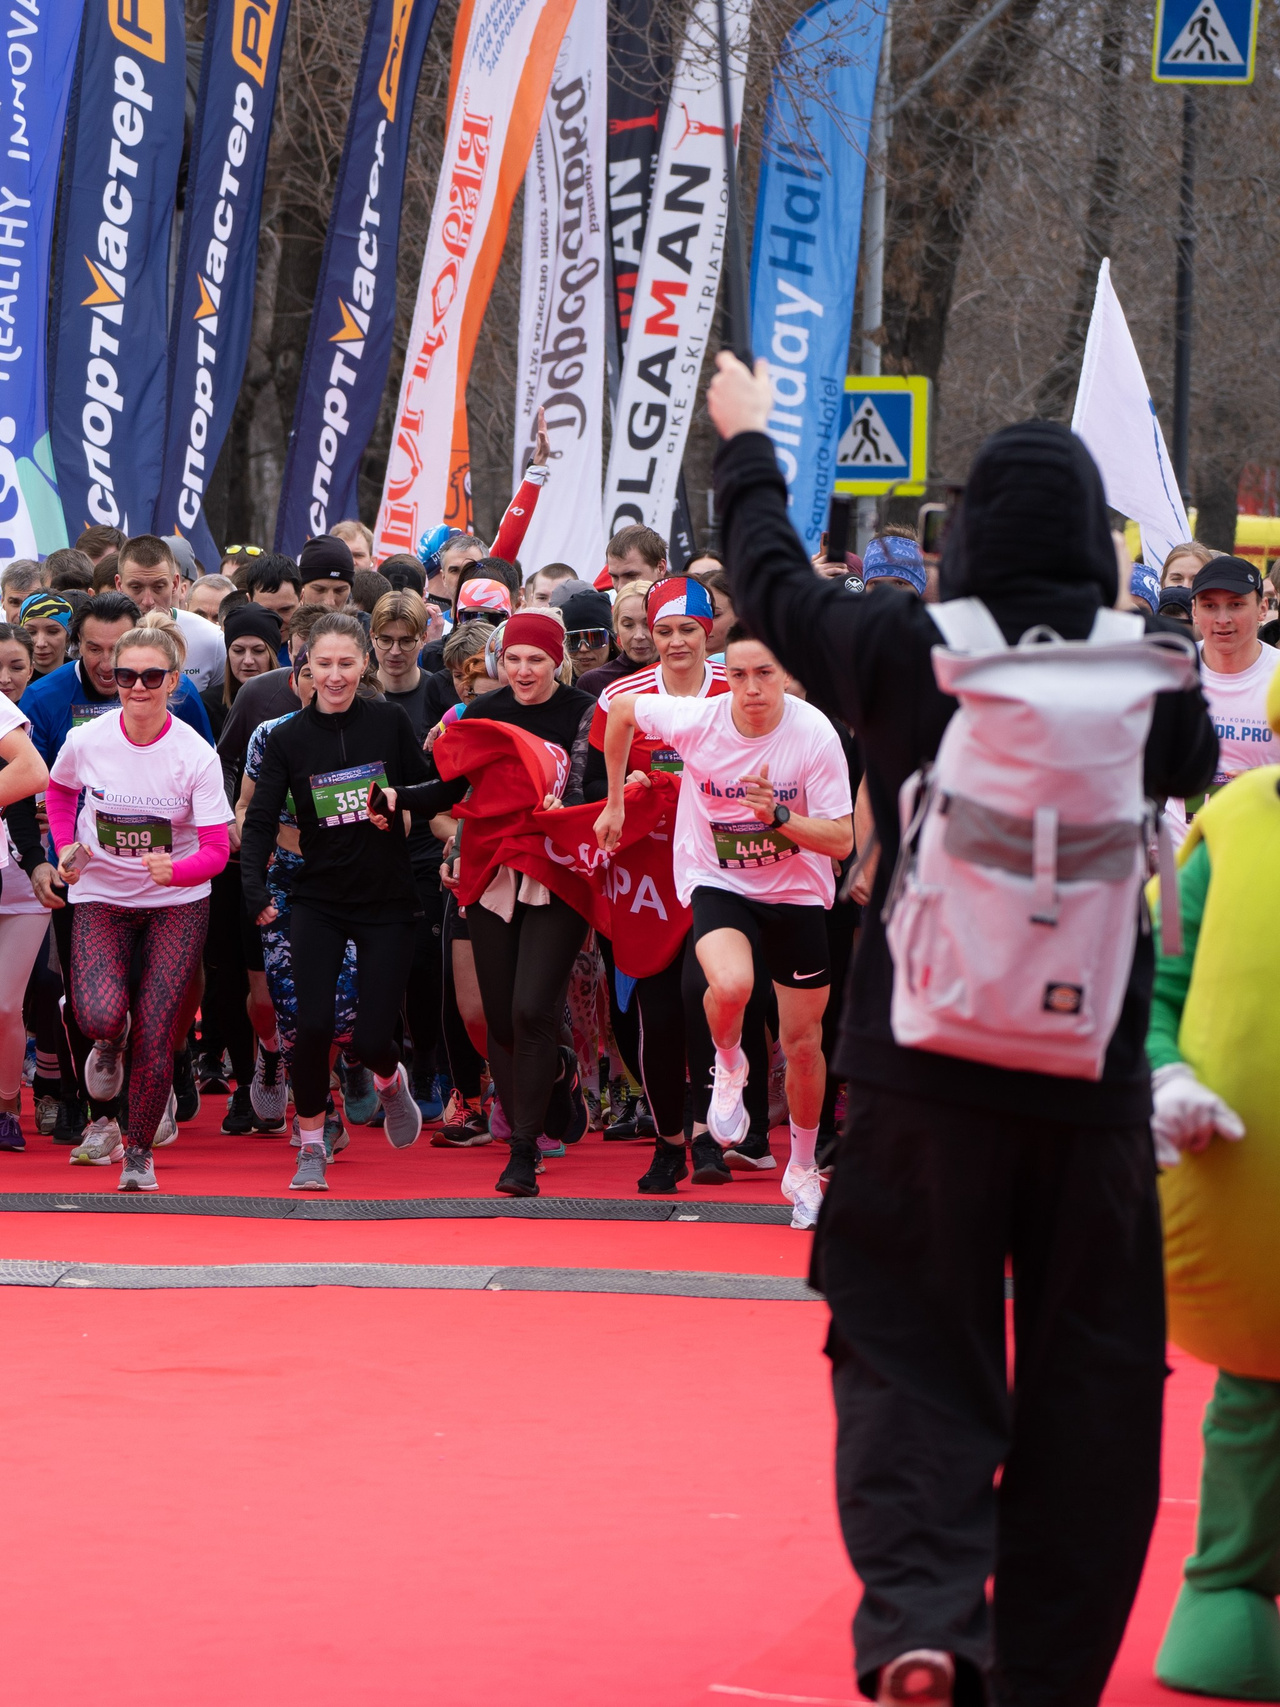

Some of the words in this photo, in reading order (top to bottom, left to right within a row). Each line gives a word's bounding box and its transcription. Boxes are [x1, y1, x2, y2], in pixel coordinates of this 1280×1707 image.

[768, 142, 824, 277] Hall
[817, 374, 839, 440] Hotel
[804, 445, 831, 543] Samara
[106, 793, 144, 805] ОПОРА
[146, 796, 191, 807] РОССИИ
[334, 787, 369, 813] 355
[116, 830, 152, 847] 509
[735, 838, 777, 858] 444
